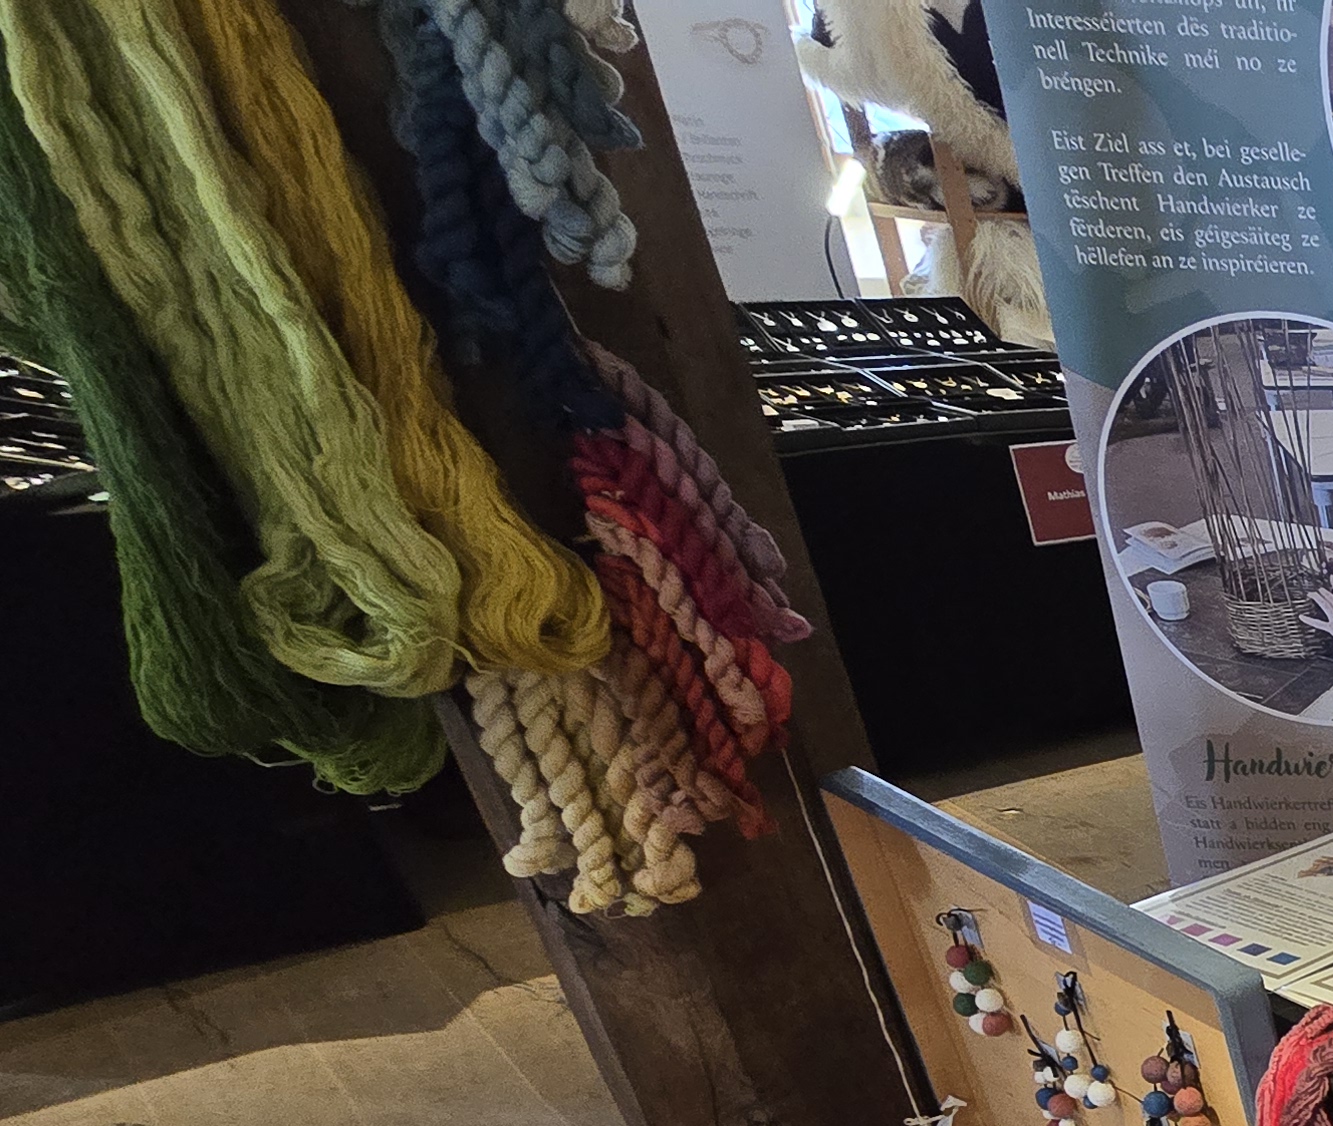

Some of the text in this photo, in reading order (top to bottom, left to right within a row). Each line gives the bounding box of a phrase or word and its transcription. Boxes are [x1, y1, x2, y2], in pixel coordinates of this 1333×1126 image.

[1177, 16, 1210, 38] dës
[1220, 20, 1297, 43] traditio-
[1033, 40, 1297, 74] nell Technike méi no ze
[1038, 68, 1122, 98] bréngen.
[1051, 129, 1306, 165] Eist Ziel ass et, bei geselle-
[1058, 161, 1312, 192] gen Treffen den Austausch
[1158, 193, 1279, 218] Handwierker
[1298, 205, 1317, 220] ze
[1160, 223, 1184, 242] eis
[1301, 232, 1320, 248] ze
[1152, 255, 1174, 270] an
[1179, 255, 1197, 271] ze
[1047, 489, 1086, 501] Mathias
[1304, 820, 1330, 834] eng
